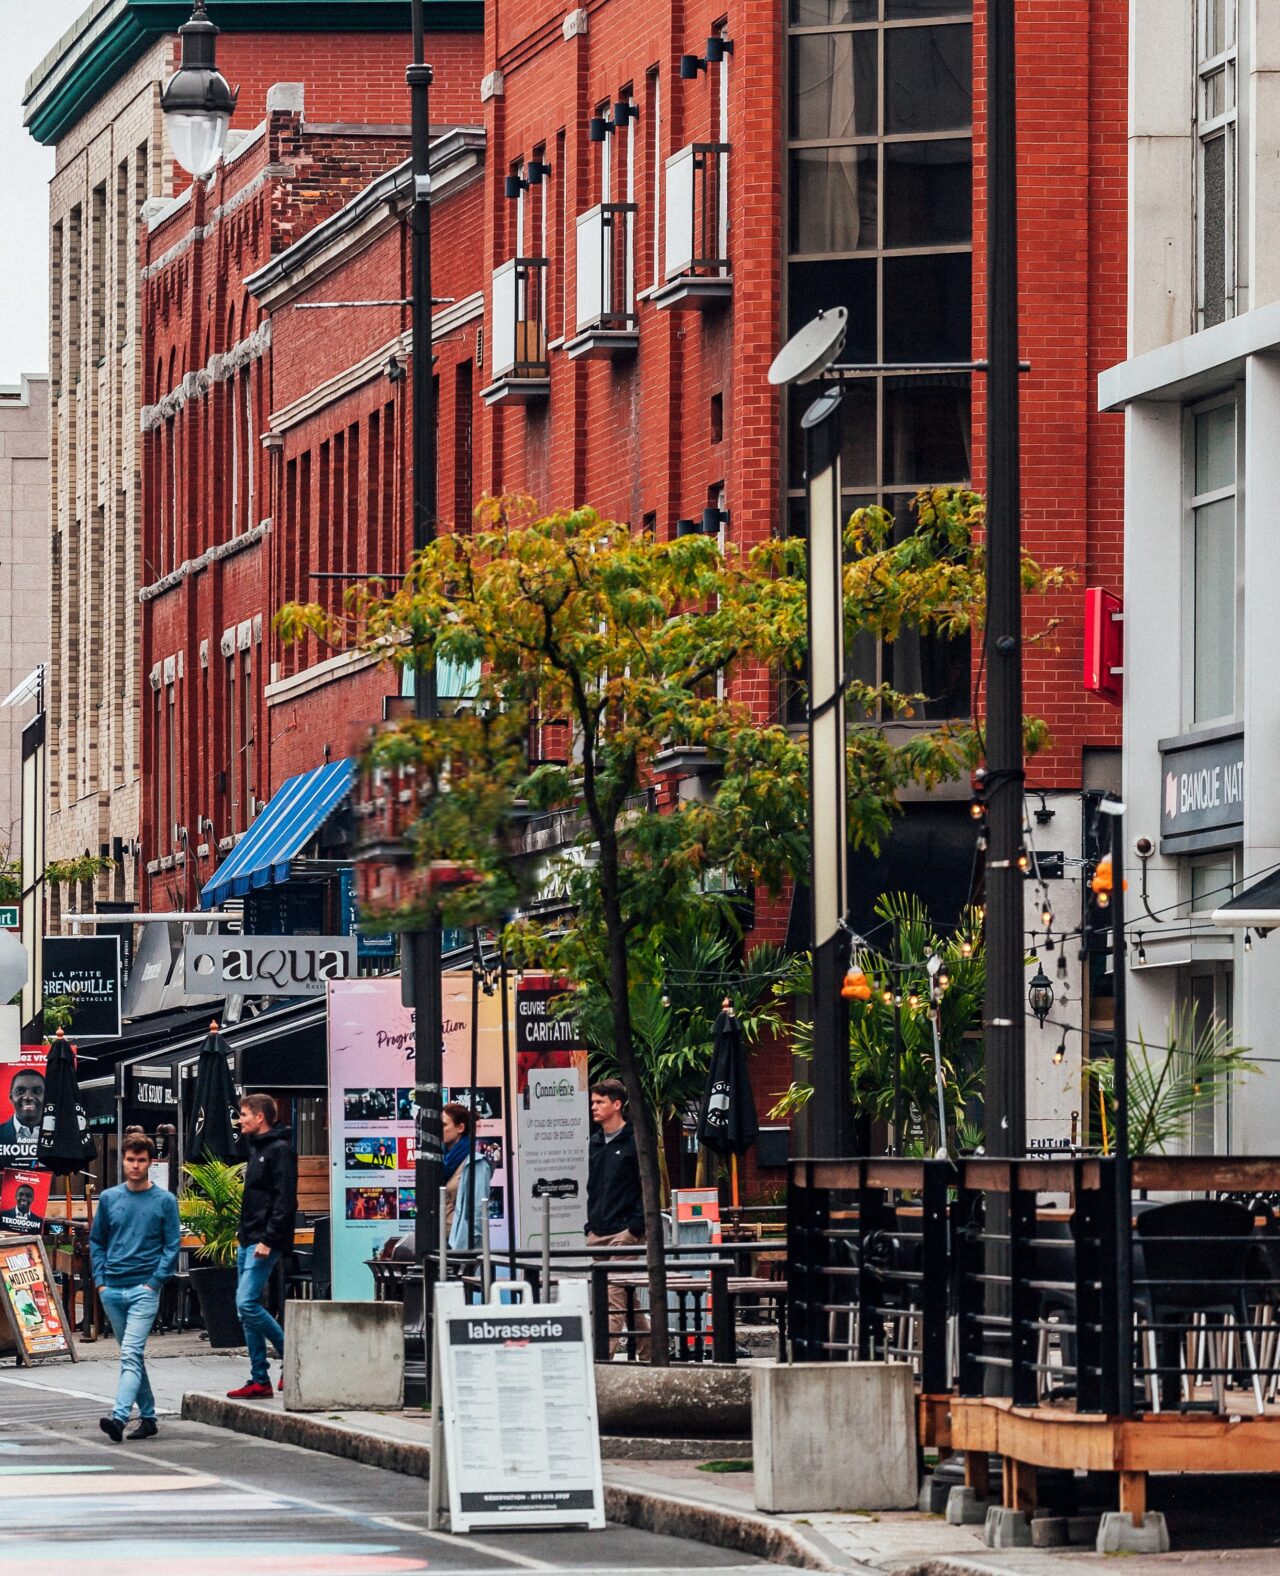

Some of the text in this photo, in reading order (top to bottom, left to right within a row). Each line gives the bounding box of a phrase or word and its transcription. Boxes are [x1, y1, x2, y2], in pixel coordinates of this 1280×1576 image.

[1180, 766, 1221, 813] BANQUE
[70, 970, 101, 978] P'TITE
[43, 979, 114, 995] GRENOUILLE
[525, 1021, 580, 1042] CARITATIVE
[9, 1268, 40, 1287] MOJITOS
[468, 1320, 563, 1339] labrasserie
